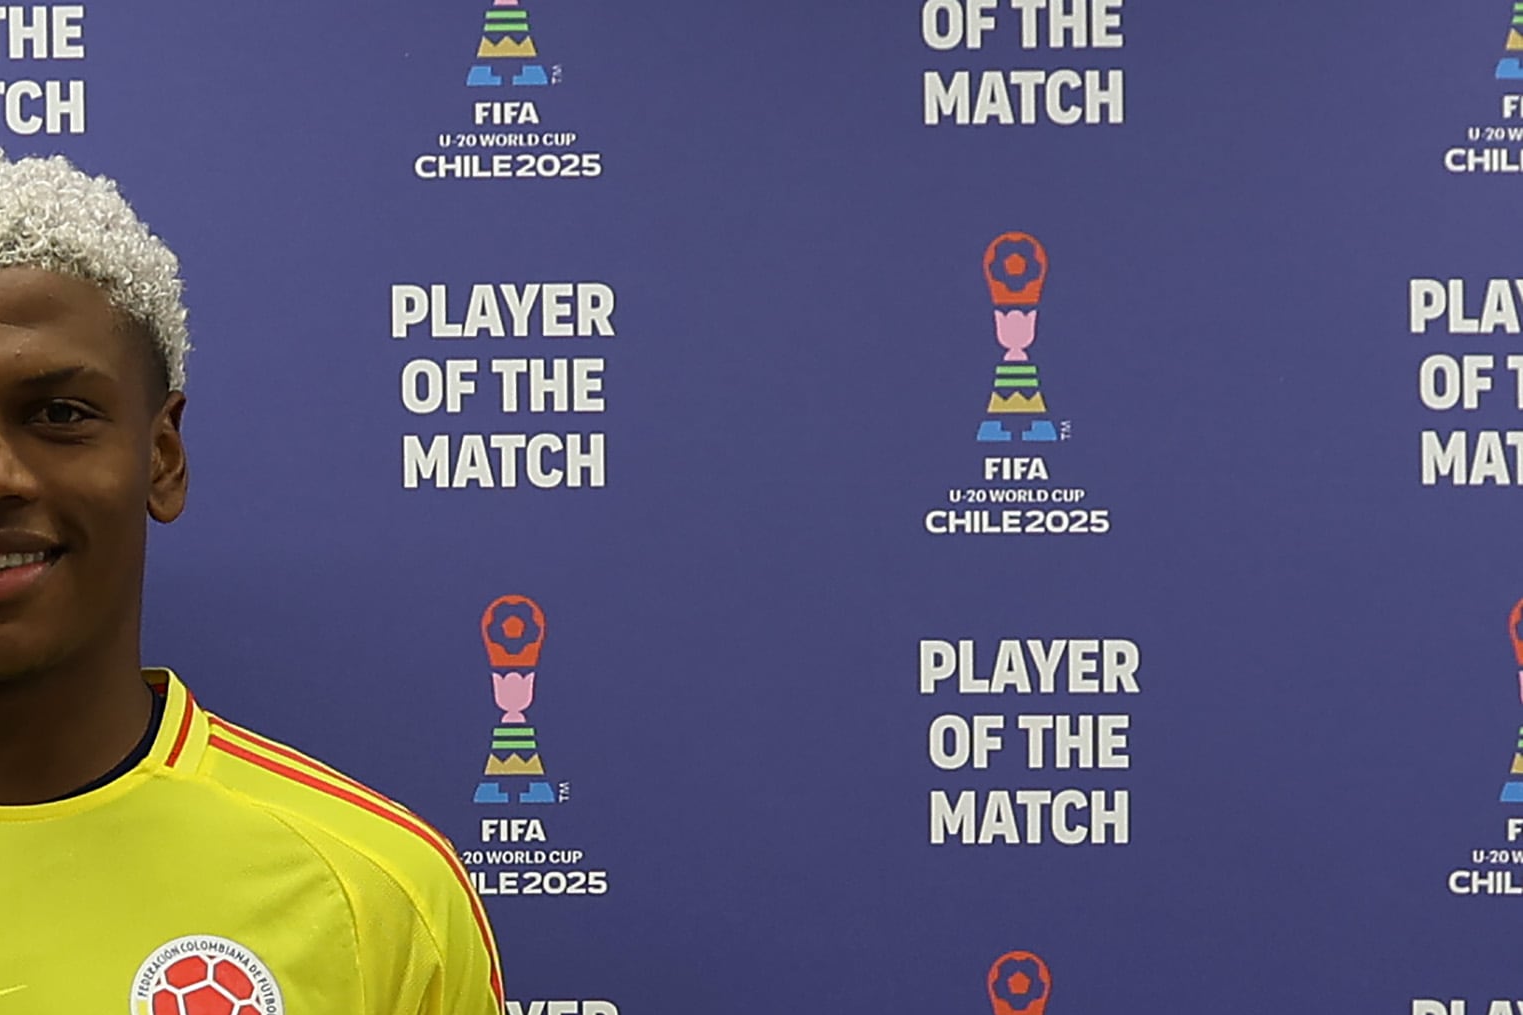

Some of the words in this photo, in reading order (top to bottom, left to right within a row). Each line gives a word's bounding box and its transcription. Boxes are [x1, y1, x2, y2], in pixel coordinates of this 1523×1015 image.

[922, 0, 998, 51] OF
[1010, 0, 1124, 50] THE
[474, 101, 540, 126] FIFA
[923, 69, 1124, 126] MATCH
[438, 132, 477, 149] U-20
[478, 132, 540, 149] WORLD
[541, 132, 577, 149] CUP
[391, 282, 616, 339] PLAYER
[1409, 278, 1523, 335] PLA
[401, 358, 478, 414] OF
[490, 357, 605, 413] THE
[1419, 353, 1494, 411] OF
[402, 432, 605, 489] MATCH
[984, 456, 1049, 481] FIFA
[1421, 430, 1523, 487] MAT
[949, 488, 987, 504] U-20
[988, 488, 1049, 504] WORLD
[1050, 488, 1086, 504] CUP
[919, 638, 1141, 694] PLAYER
[929, 714, 1005, 770] OF
[1017, 714, 1130, 769] THE
[481, 818, 547, 843] FIFA
[930, 789, 1129, 845] MATCH
[485, 850, 547, 865] WORLD
[548, 850, 583, 865] CUP
[179, 939, 251, 968] COLOMBIANA
[248, 963, 262, 979] DE
